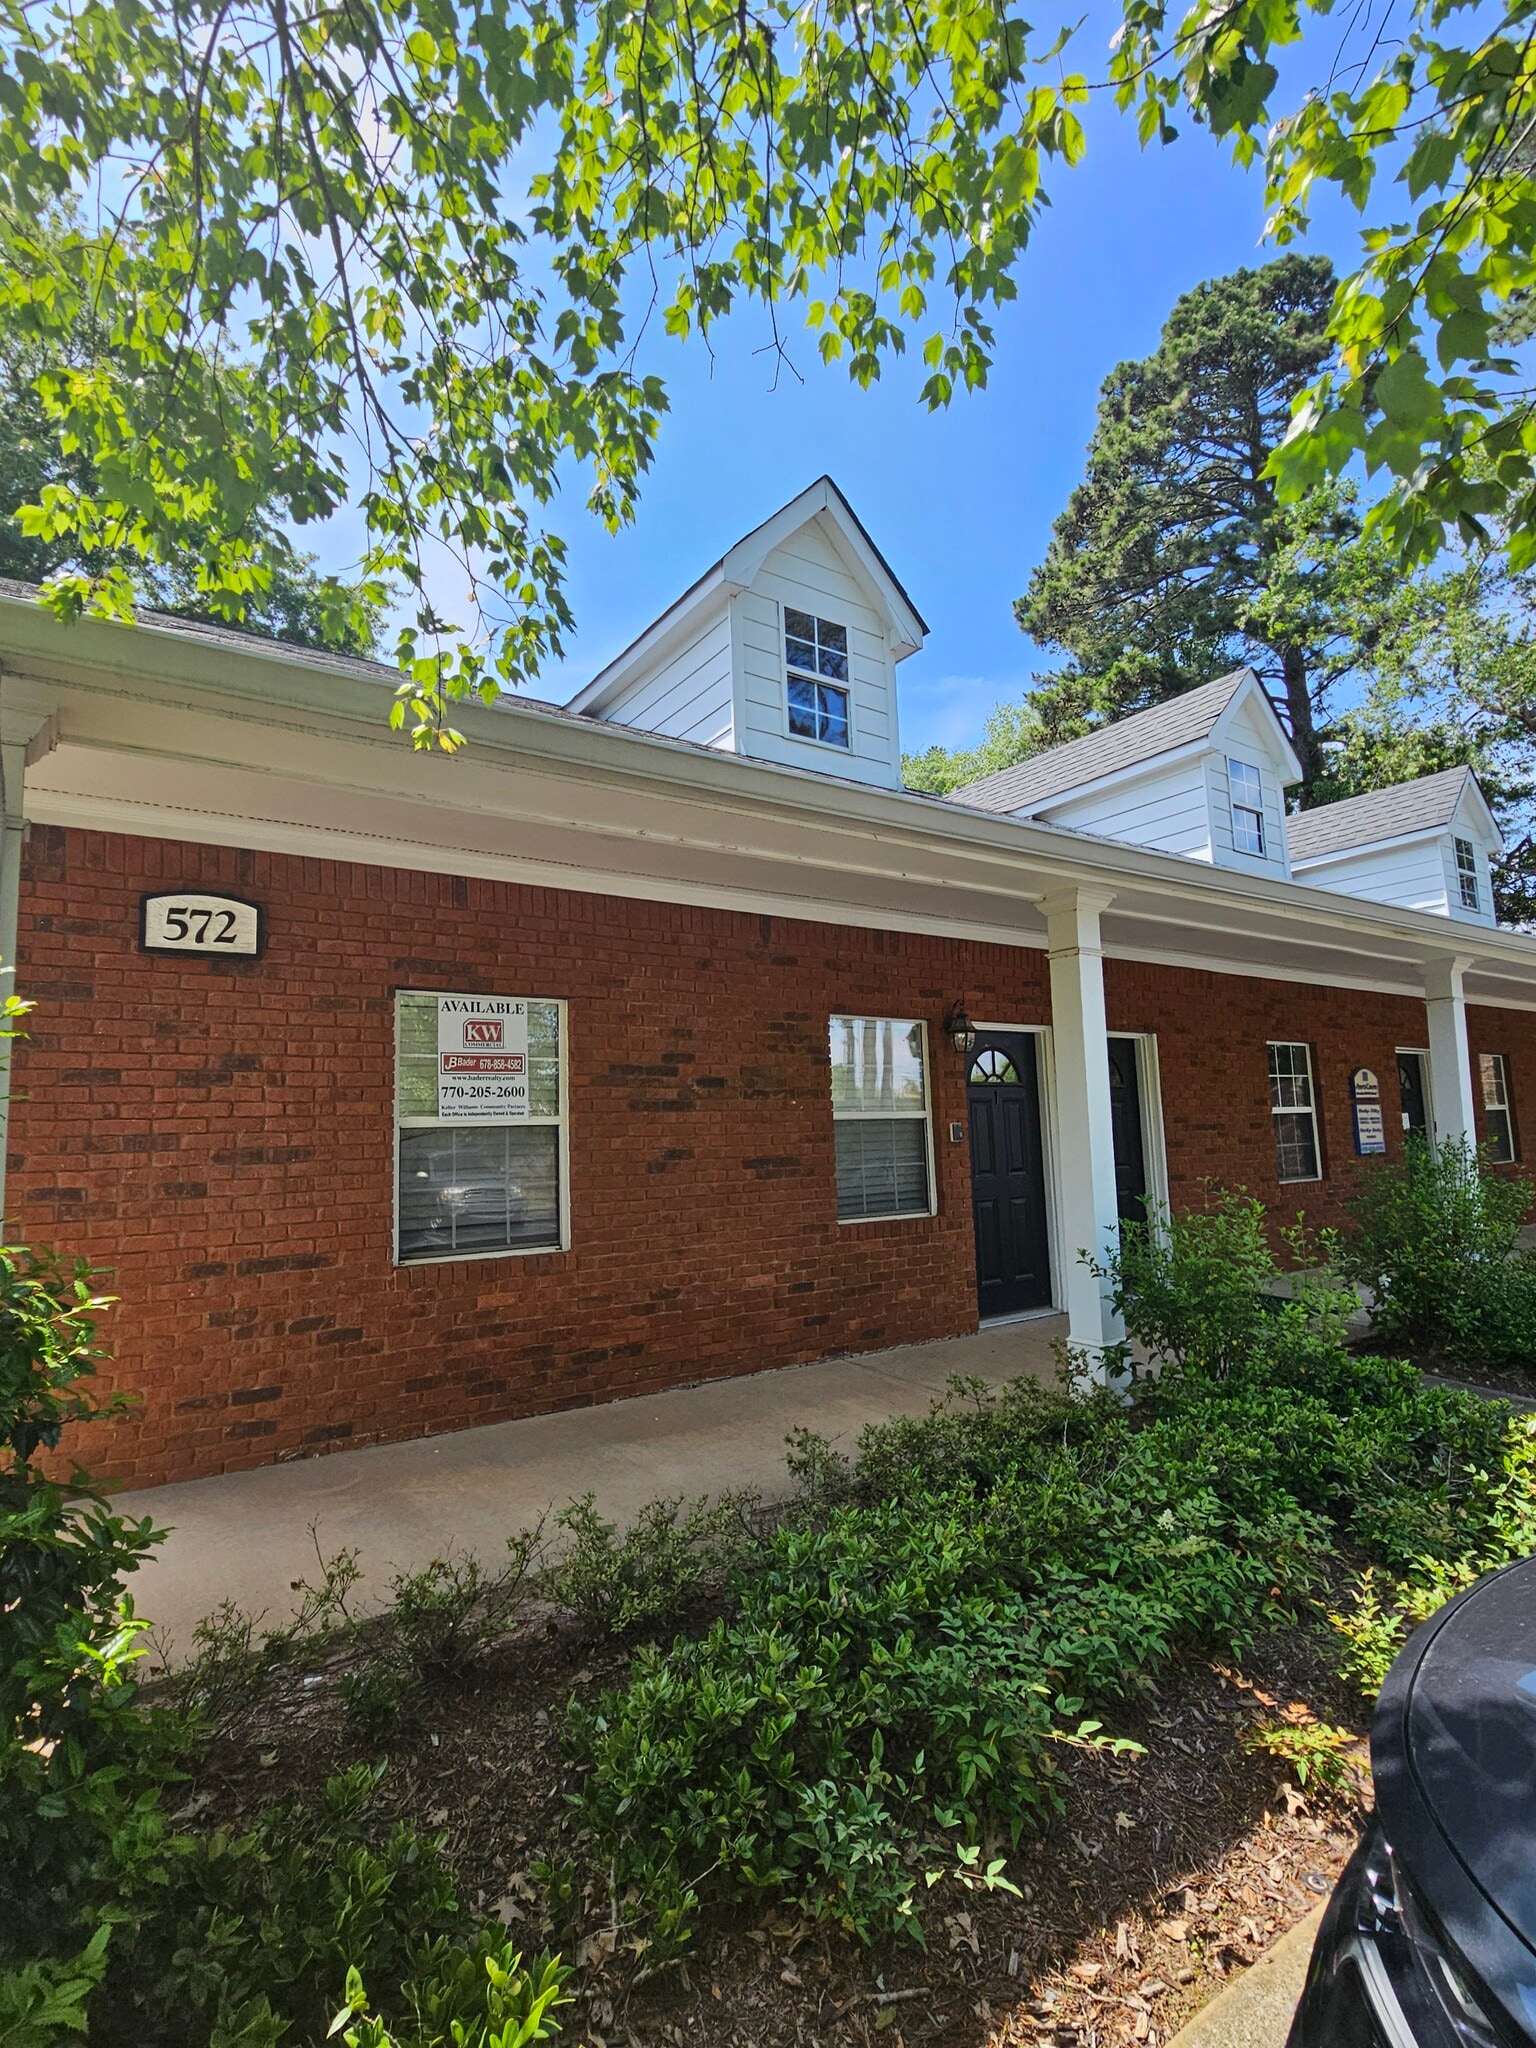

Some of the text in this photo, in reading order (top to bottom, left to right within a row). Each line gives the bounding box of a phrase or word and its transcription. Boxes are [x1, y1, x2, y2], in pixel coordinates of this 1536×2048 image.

[162, 907, 237, 944] 572
[441, 1000, 525, 1015] AVAILABLE
[466, 1024, 501, 1041] KW
[457, 1057, 477, 1067] Bader
[479, 1058, 522, 1070] 678-858-4582
[441, 1086, 525, 1098] 770-205-2600
